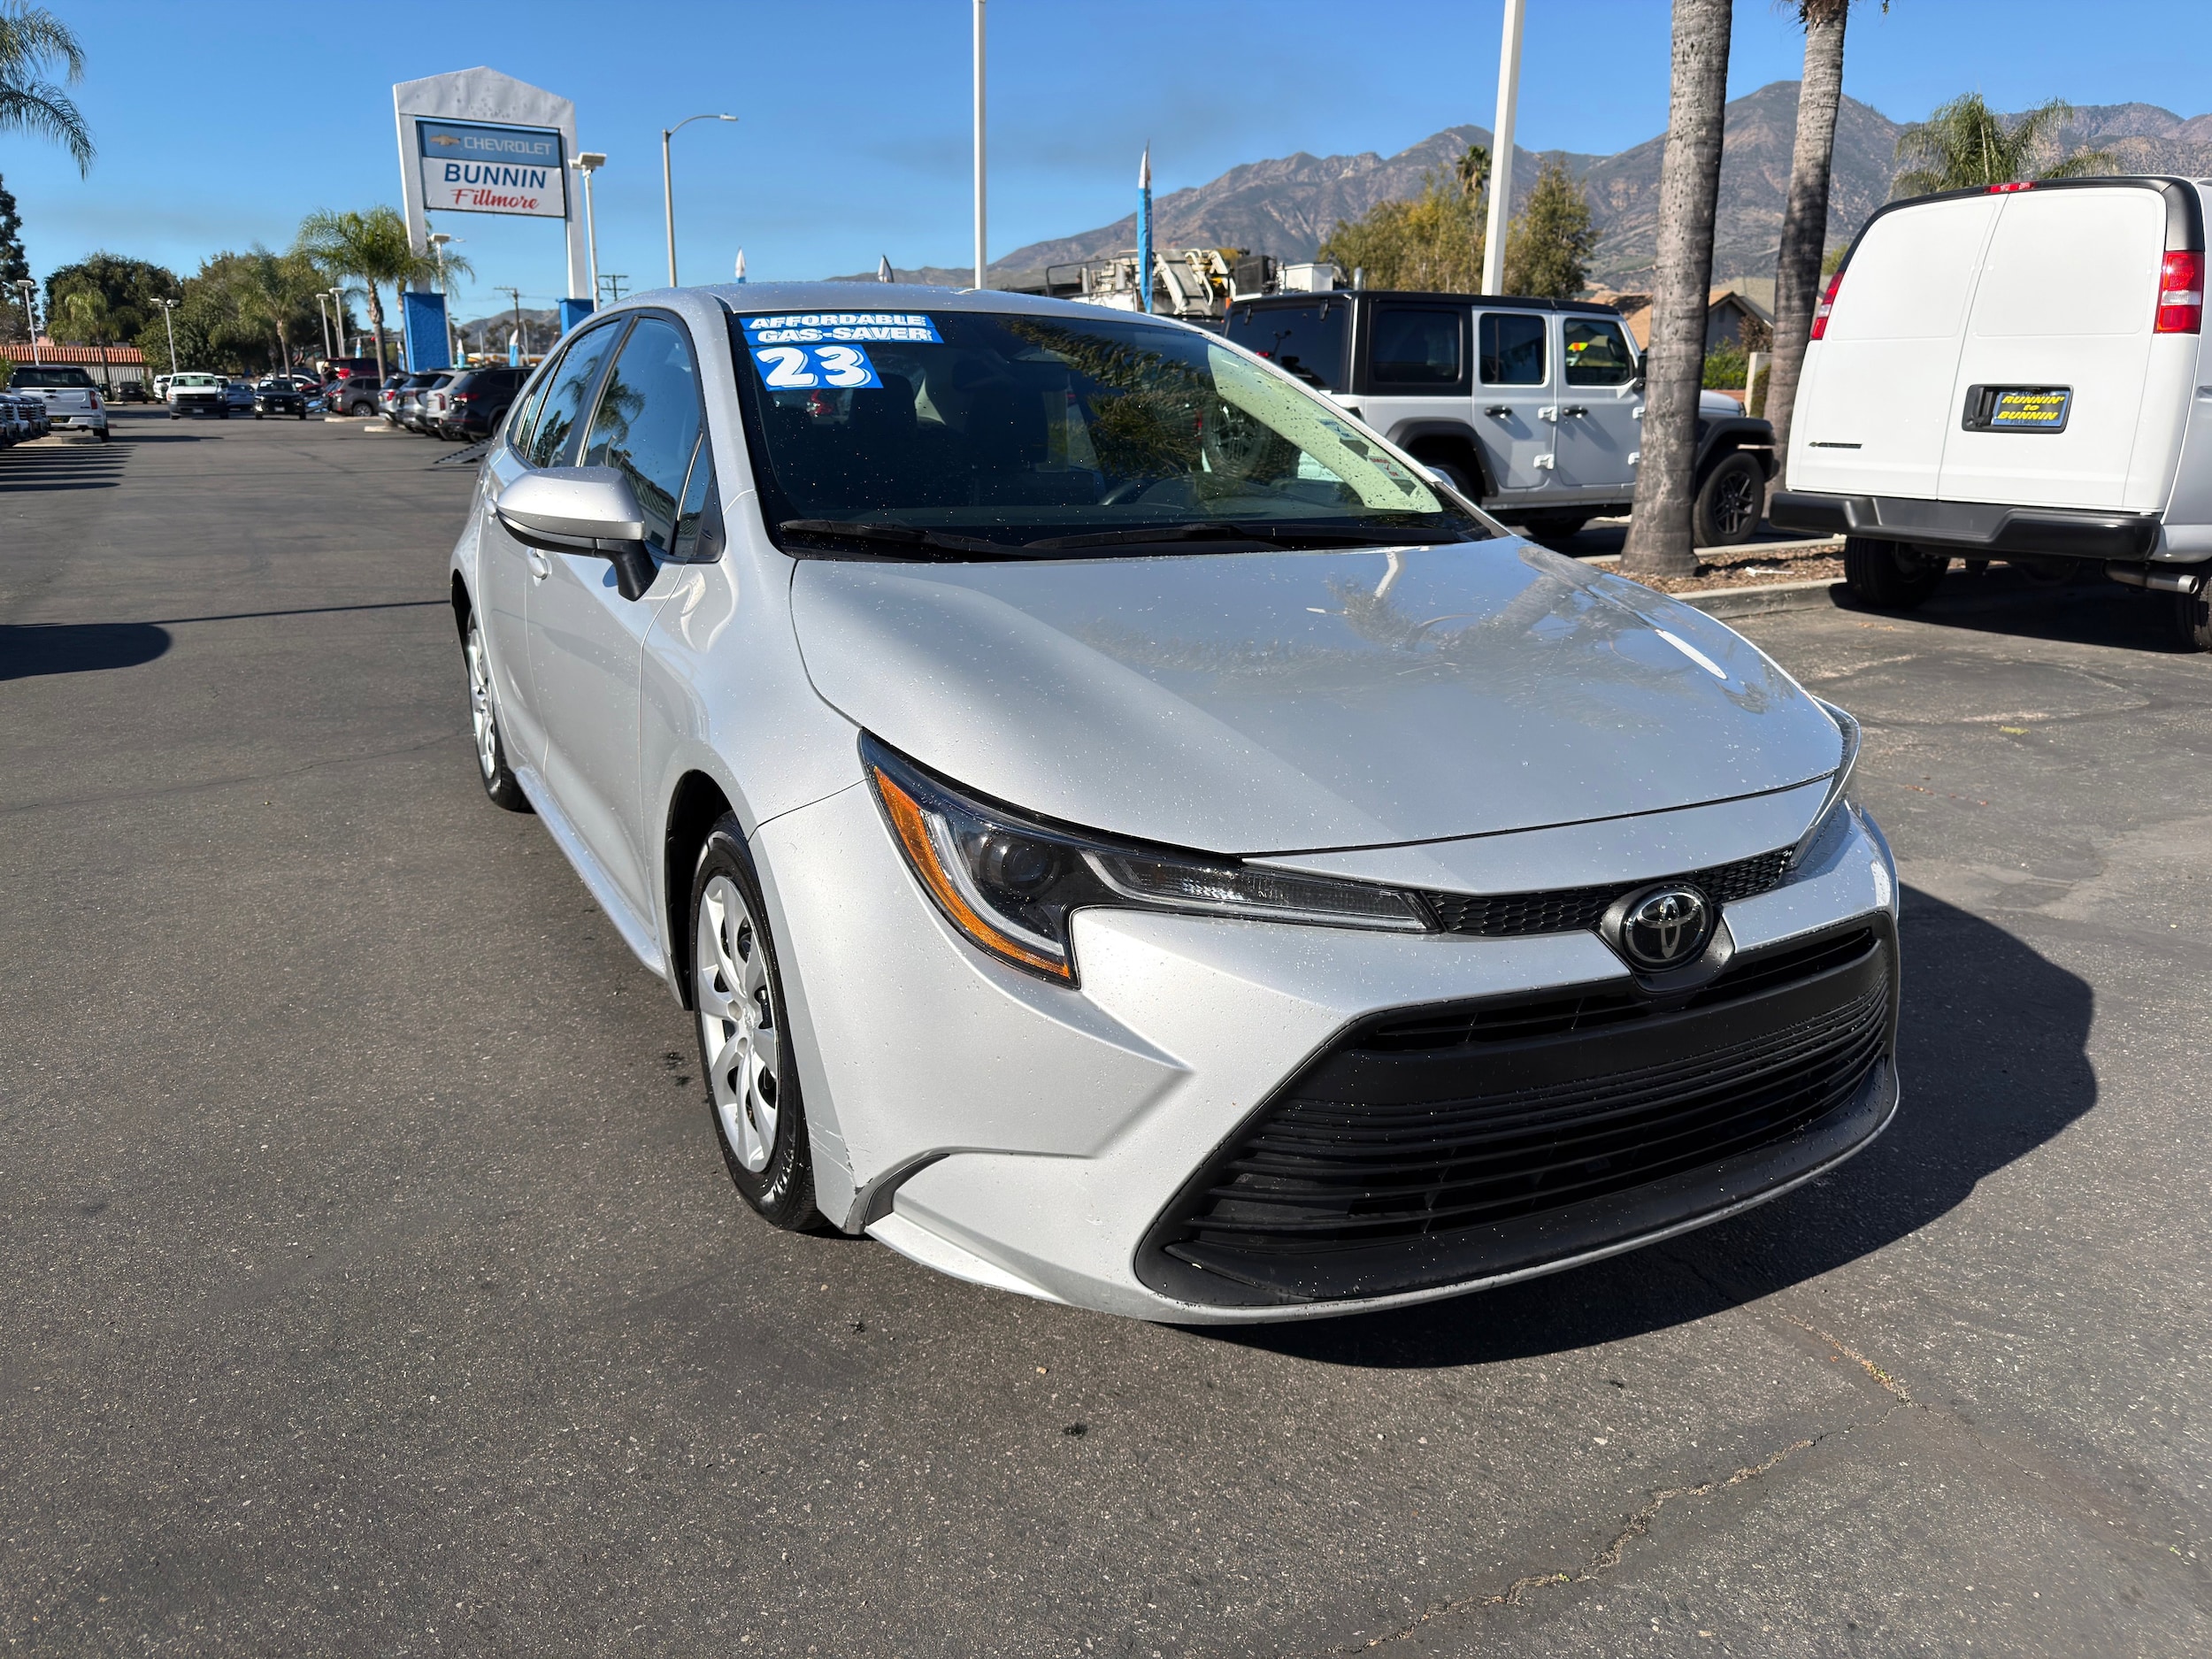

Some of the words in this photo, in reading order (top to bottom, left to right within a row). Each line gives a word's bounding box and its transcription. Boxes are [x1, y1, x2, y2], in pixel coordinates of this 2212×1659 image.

[464, 136, 551, 155] CHEVROLET
[444, 164, 546, 188] BUNNIN
[450, 188, 539, 210] Fillmore
[749, 314, 926, 329] AFFORDABLE
[757, 327, 933, 343] GAS-SAVER
[757, 346, 872, 388] 23
[2001, 396, 2065, 404] RUNNIN'
